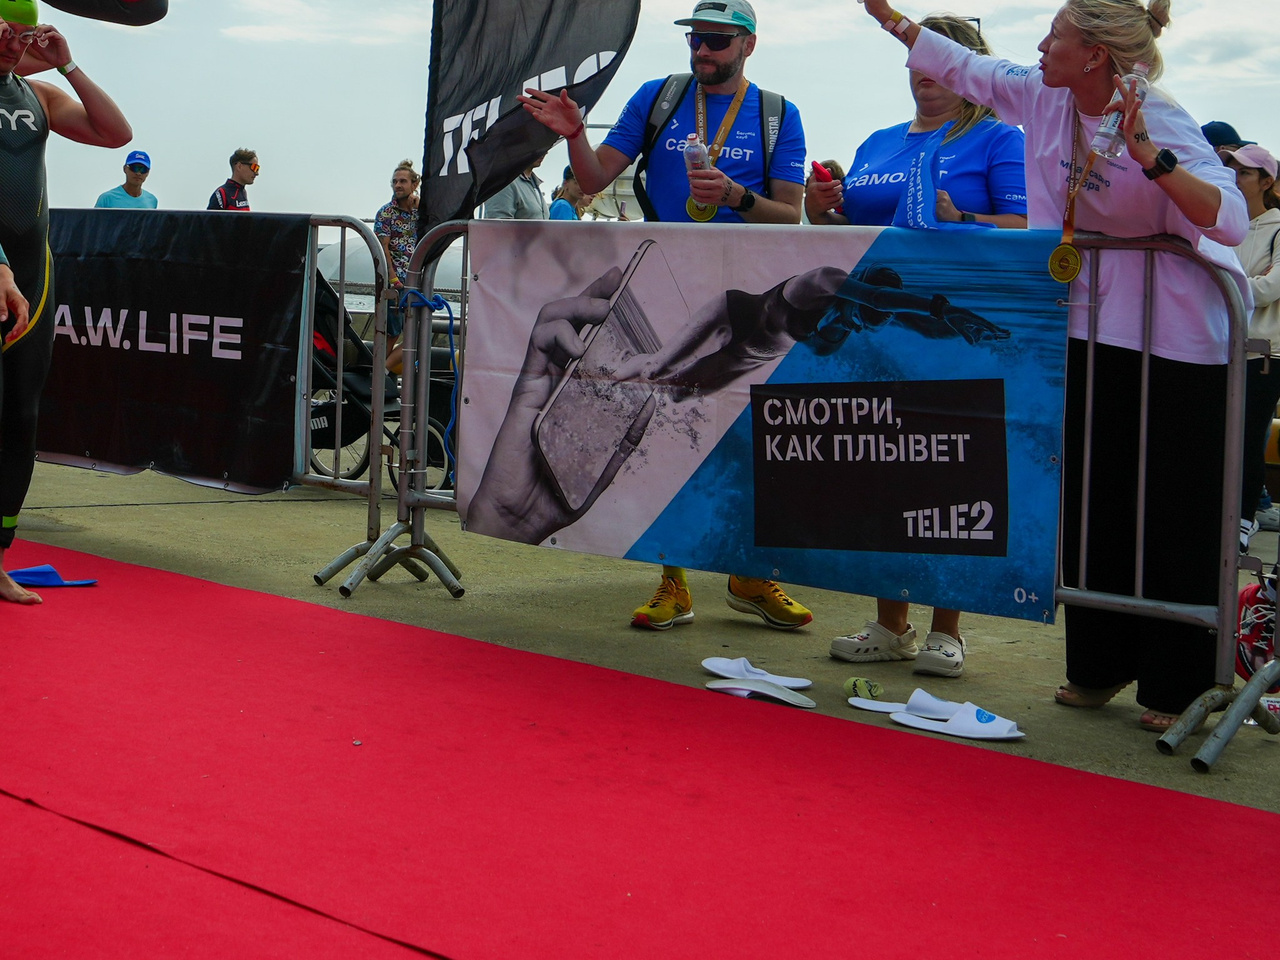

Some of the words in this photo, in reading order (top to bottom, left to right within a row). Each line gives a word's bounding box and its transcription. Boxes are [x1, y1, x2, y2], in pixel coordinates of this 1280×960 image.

[763, 397, 902, 429] СМОТРИ,
[765, 434, 824, 461] КАК
[833, 433, 970, 462] ПЛЫВЕТ
[902, 500, 994, 540] TELE2
[1013, 587, 1039, 603] 0+
